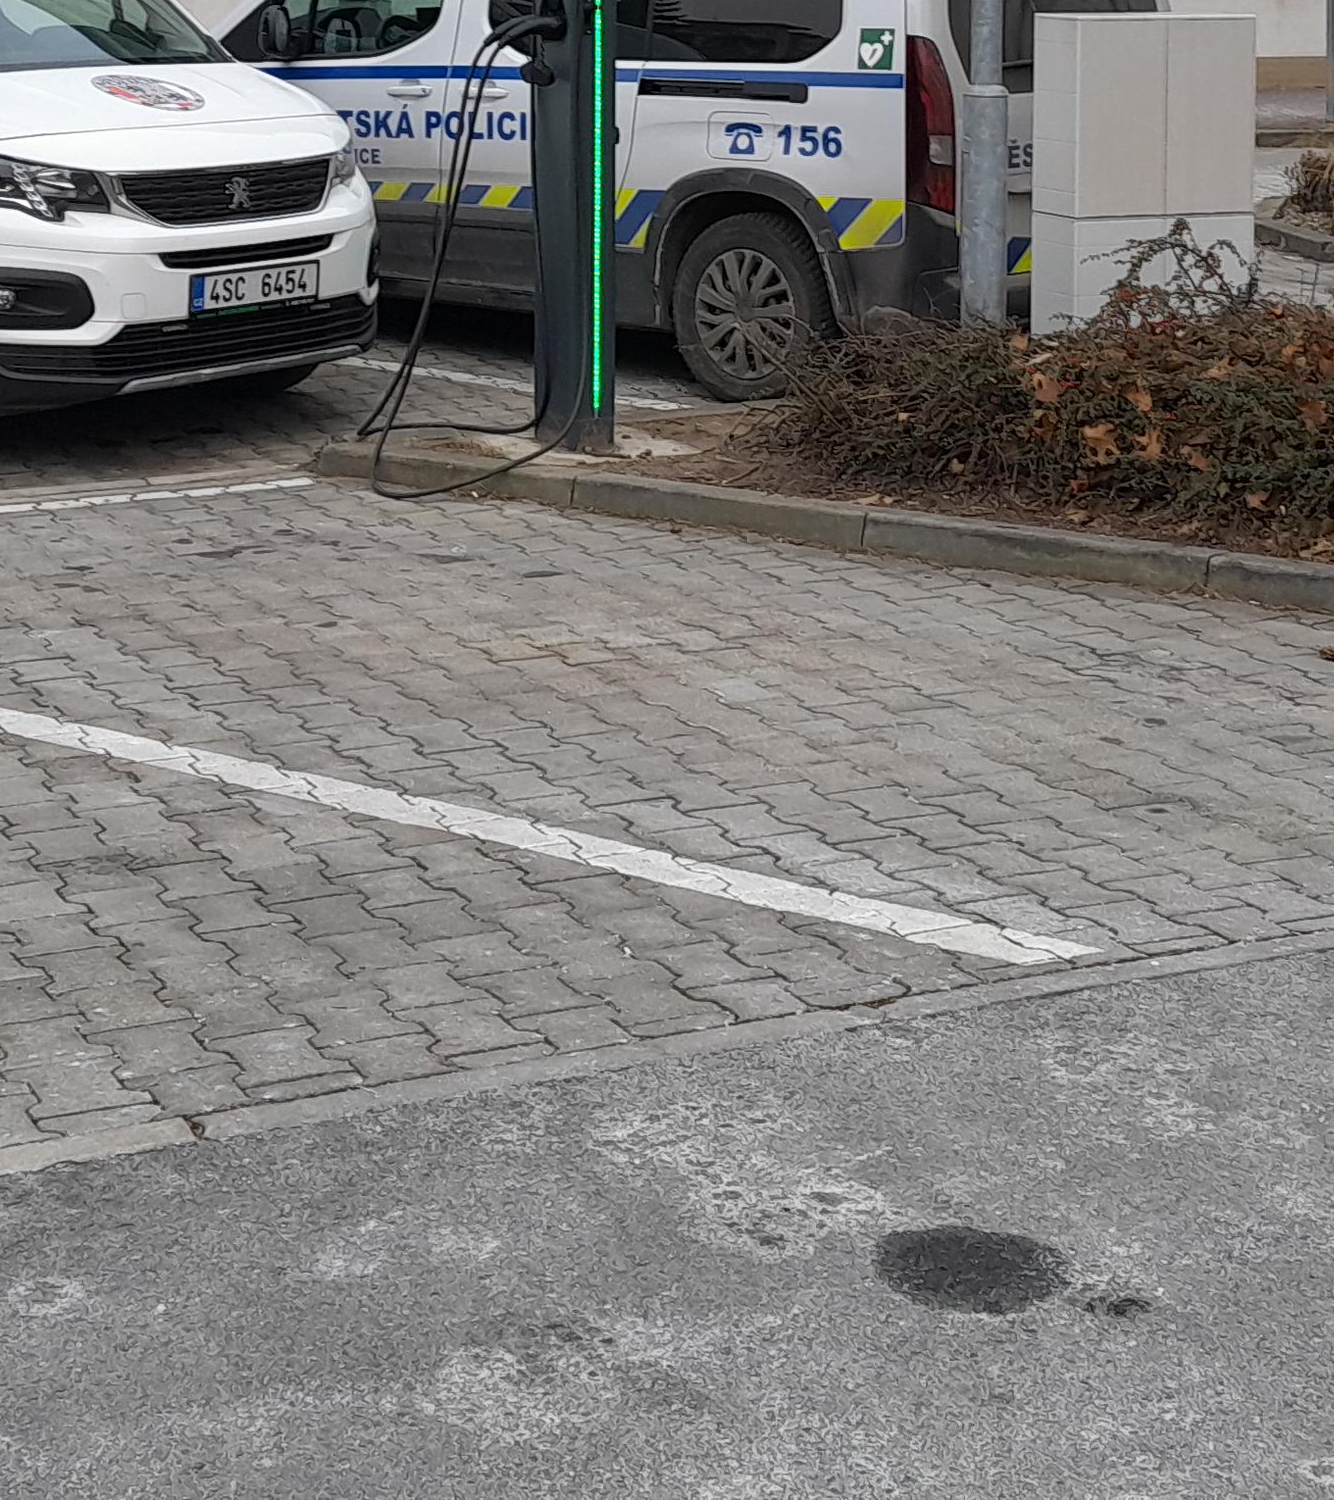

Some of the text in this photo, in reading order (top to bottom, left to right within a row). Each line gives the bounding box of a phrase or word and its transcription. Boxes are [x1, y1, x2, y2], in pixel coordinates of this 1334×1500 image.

[424, 110, 527, 141] POLICI
[777, 124, 843, 158] 156
[209, 276, 246, 304] 4SC
[261, 268, 307, 298] 6454
